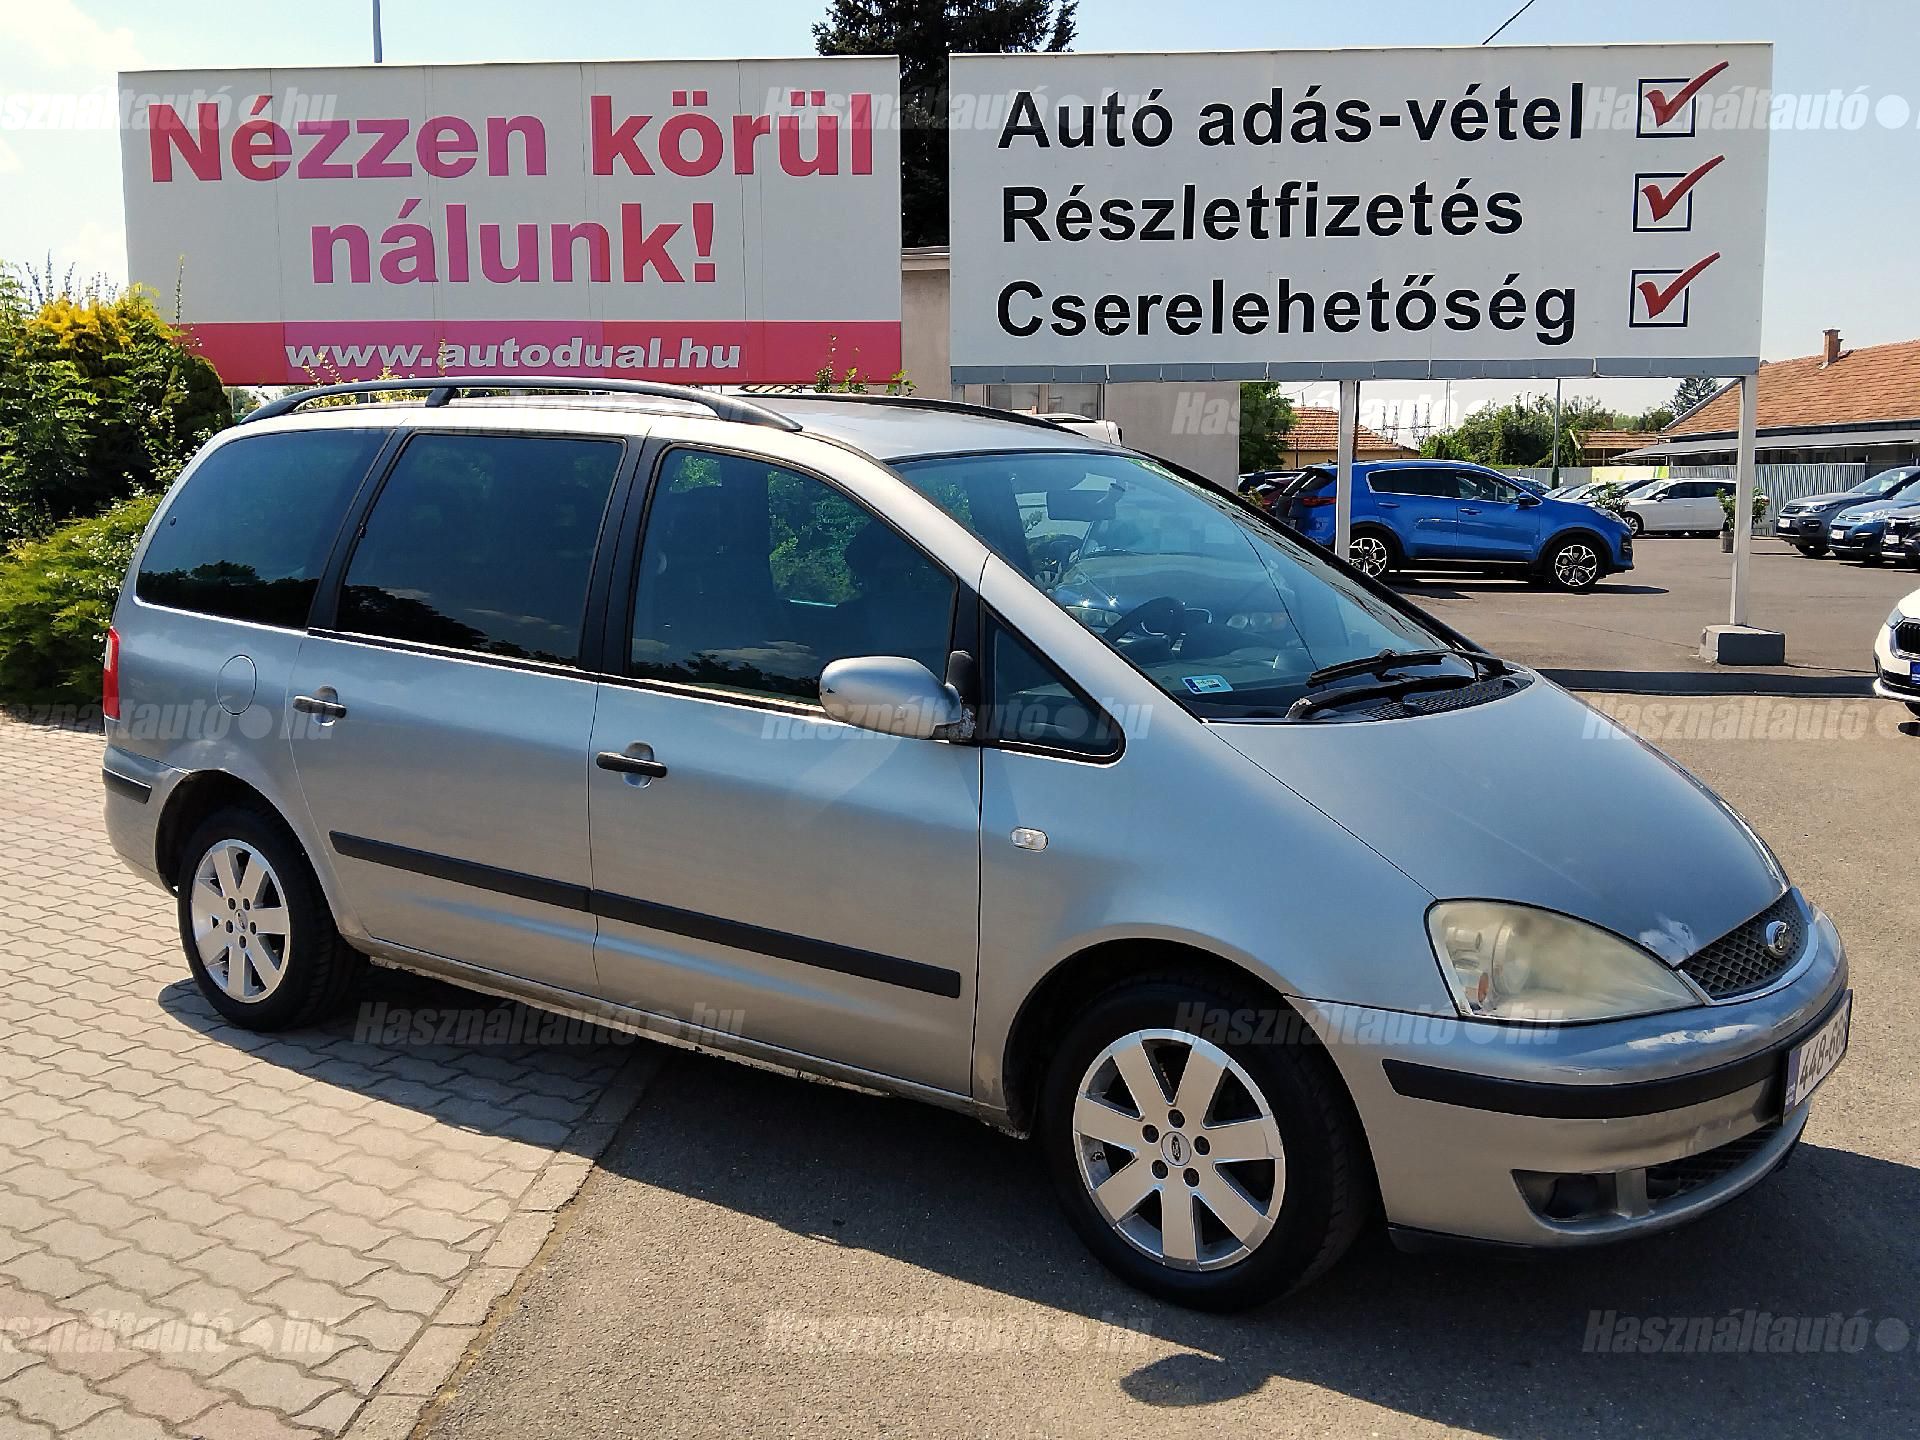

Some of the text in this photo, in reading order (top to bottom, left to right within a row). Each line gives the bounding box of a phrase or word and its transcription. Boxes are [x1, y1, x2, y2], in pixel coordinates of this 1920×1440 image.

[149, 90, 873, 183] Nézzen körül
[998, 82, 1584, 149] Autó adás-vétel
[311, 198, 716, 285] nálunk!
[1003, 177, 1523, 243] Részletfizetés
[997, 272, 1576, 346] Cserelehetőség
[284, 336, 741, 370] www.autodual.hu
